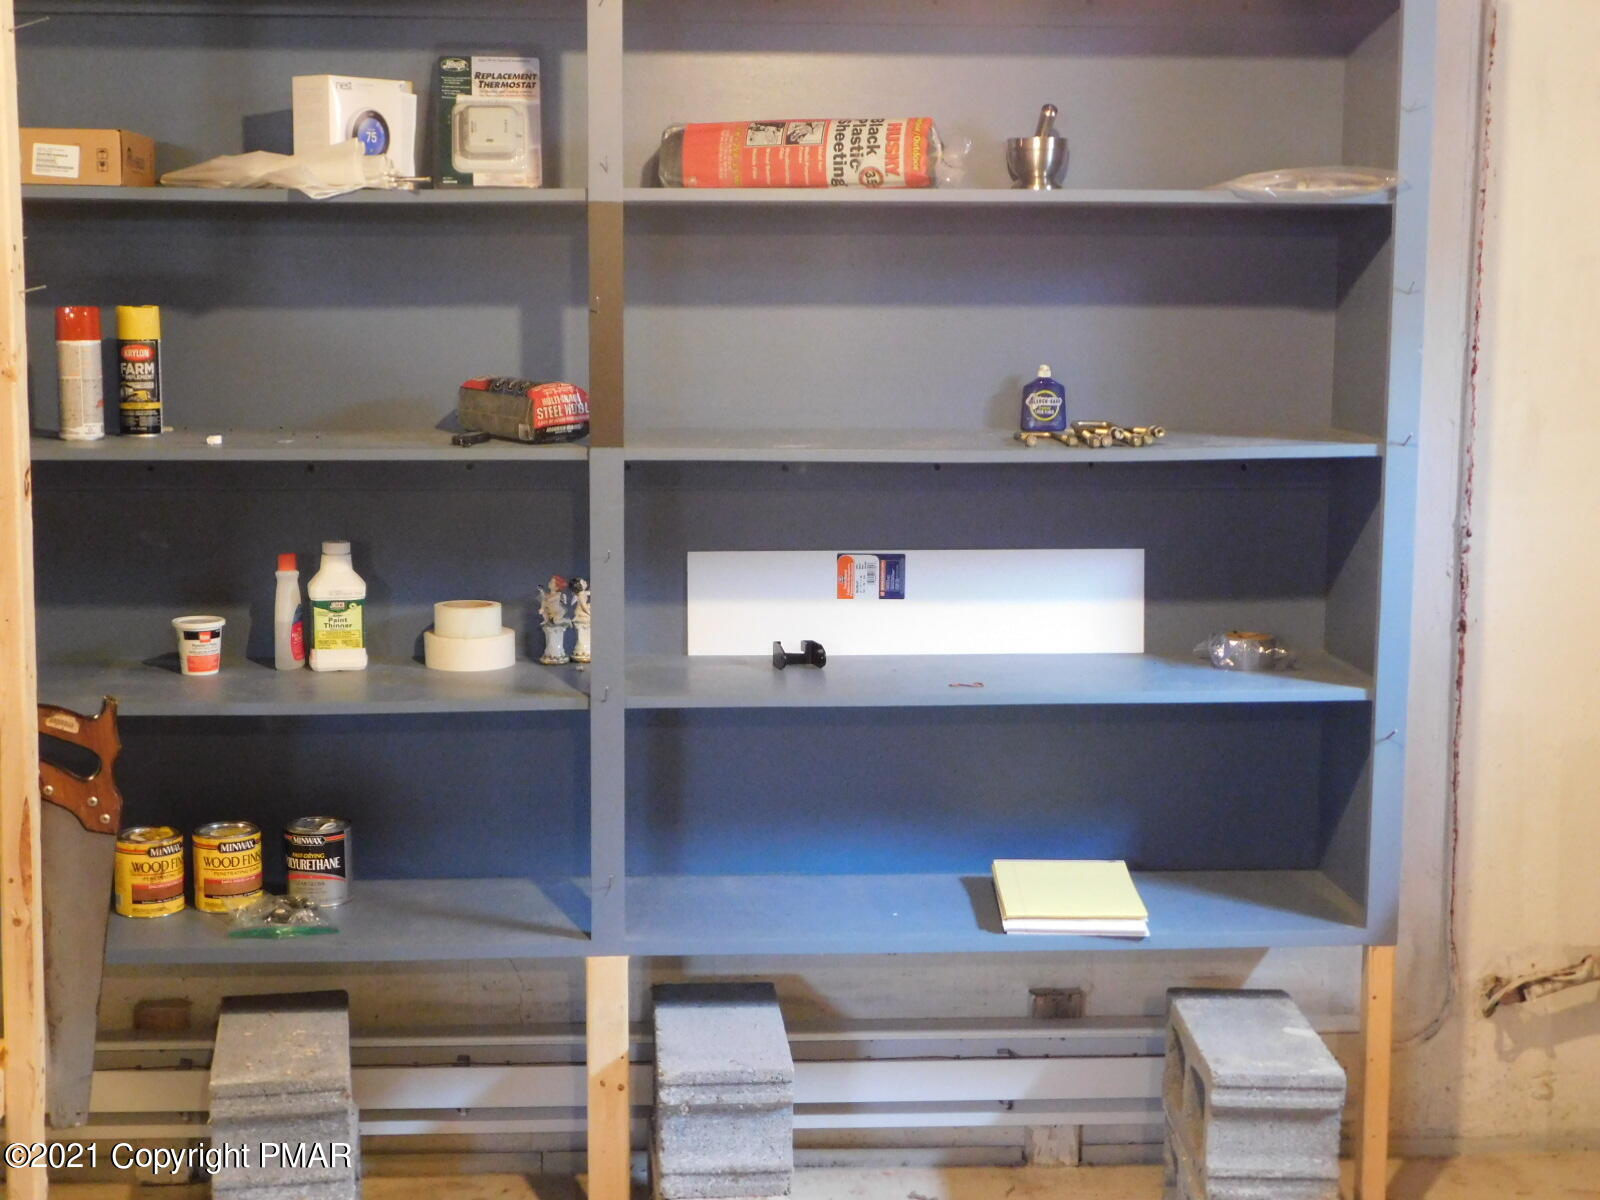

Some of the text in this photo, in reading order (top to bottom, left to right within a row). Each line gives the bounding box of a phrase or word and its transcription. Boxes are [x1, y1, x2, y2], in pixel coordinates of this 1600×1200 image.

[474, 71, 538, 81] REPLACEMENT
[478, 80, 537, 89] THERMOSTAT
[365, 131, 378, 143] 75
[884, 122, 903, 176] HUSKY
[120, 362, 155, 375] FARM
[537, 401, 590, 419] STEEL WOOL
[221, 840, 255, 852] MINWAX
[293, 836, 323, 845] MINWAX
[131, 860, 169, 873] WOOD
[203, 856, 240, 868] WOOD
